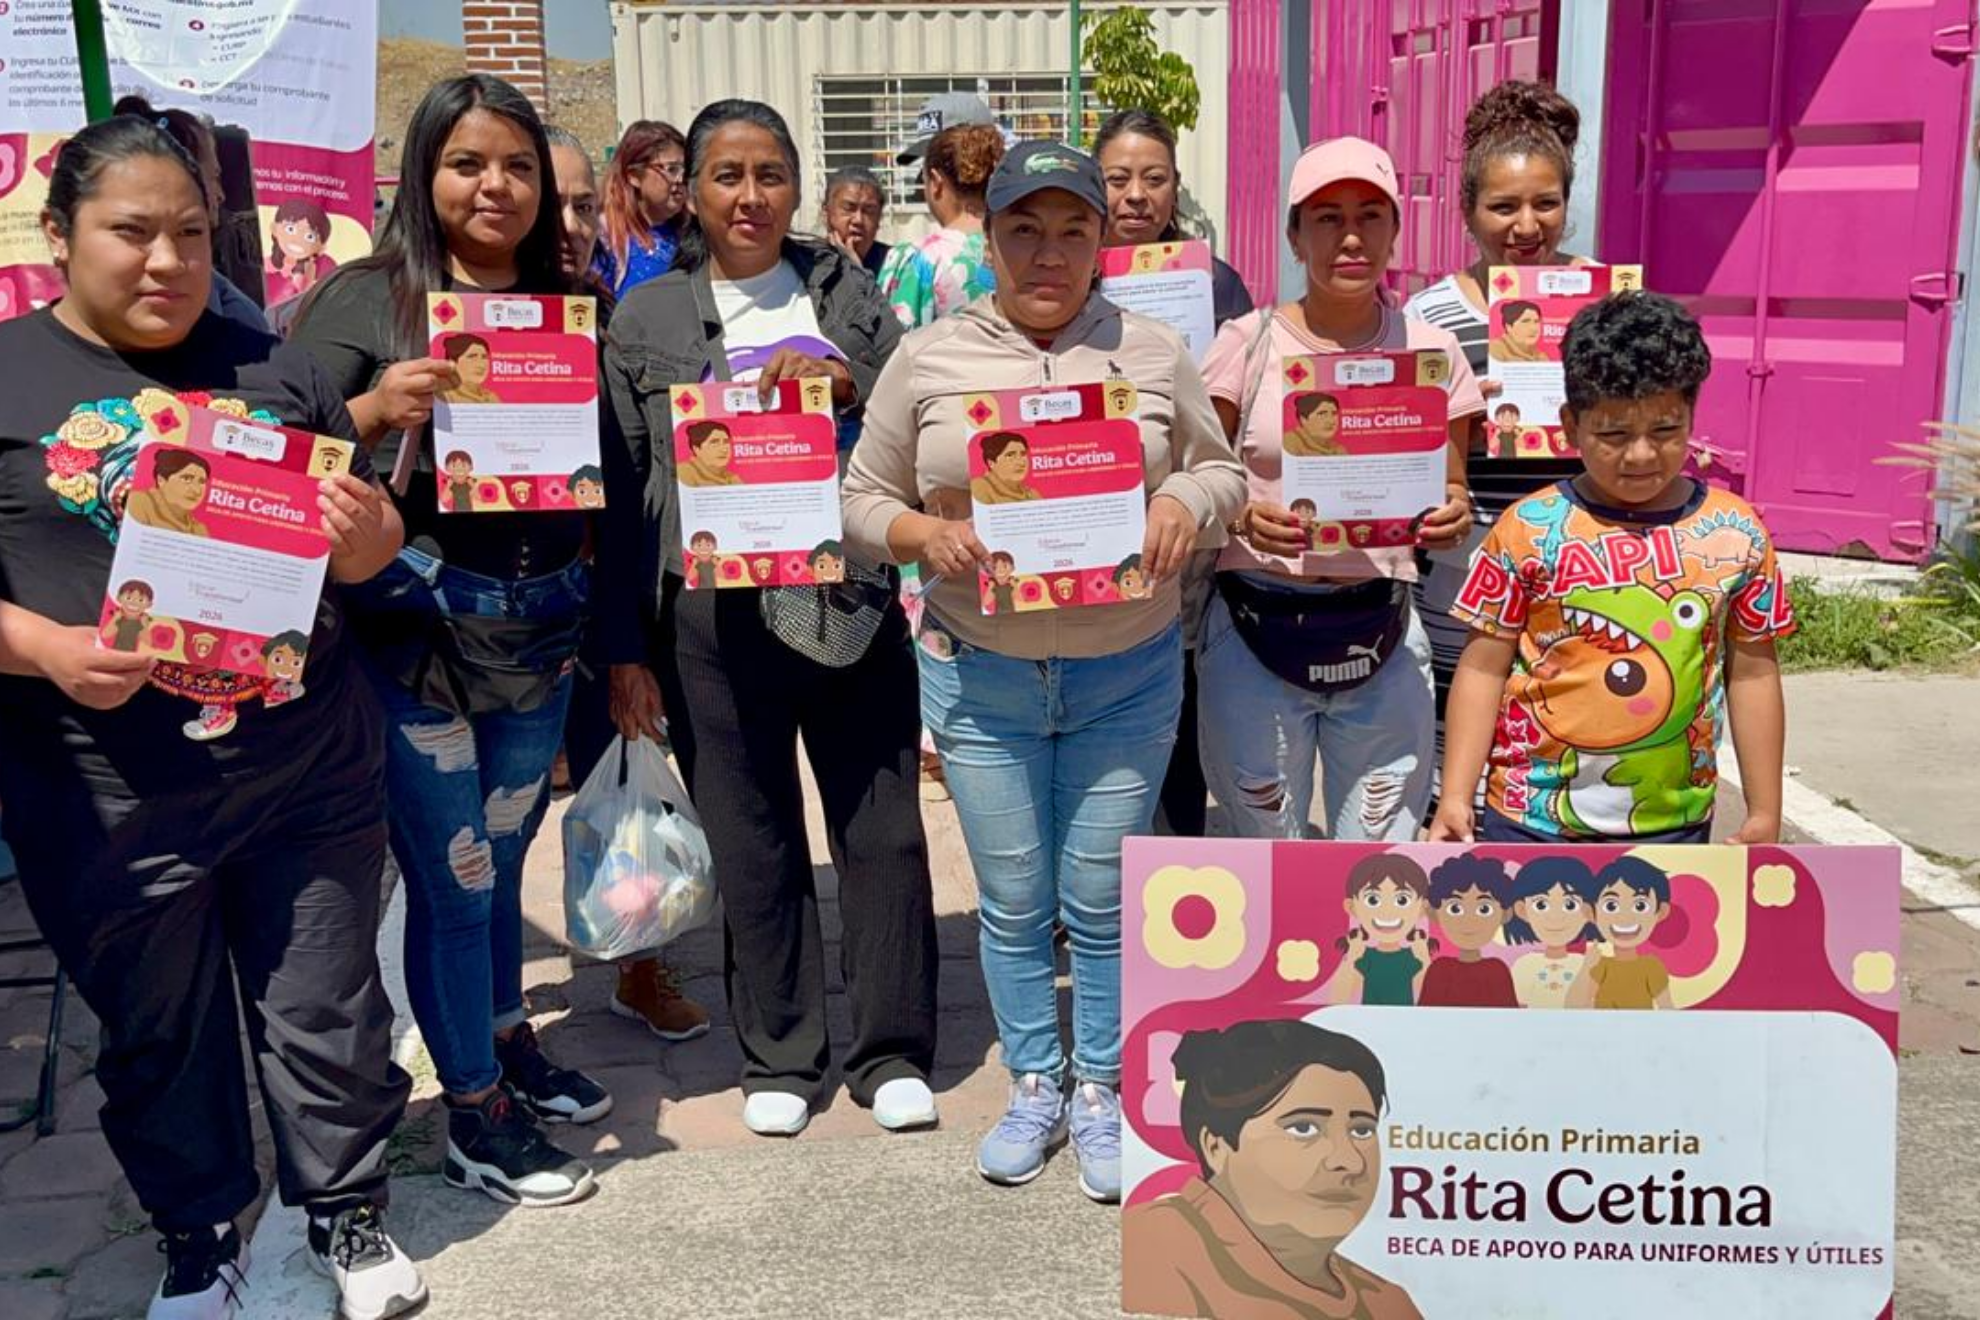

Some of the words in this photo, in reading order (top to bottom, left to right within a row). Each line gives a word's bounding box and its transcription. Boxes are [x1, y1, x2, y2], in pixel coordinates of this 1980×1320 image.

[492, 361, 522, 375] Rita
[523, 360, 572, 375] Cetina
[1341, 415, 1372, 429] Rita
[1373, 413, 1422, 428] Cetina
[733, 443, 764, 458] Rita
[765, 441, 812, 457] Cetina
[1031, 455, 1064, 471] Rita
[1065, 450, 1116, 468] Cetina
[208, 488, 246, 509] Rita
[248, 497, 306, 523] Cetina
[1309, 656, 1371, 684] PUMA
[1388, 1125, 1550, 1152] Educación
[1561, 1128, 1700, 1155] Primaria
[1388, 1165, 1527, 1223] Rita
[1546, 1168, 1772, 1227] Cetina
[1387, 1236, 1444, 1256] BECA
[1451, 1238, 1480, 1257] DE
[1486, 1239, 1567, 1260] APOYO
[1573, 1241, 1635, 1261] PARA
[1640, 1242, 1779, 1264] UNIFORMES
[1785, 1246, 1800, 1265] Y
[1806, 1241, 1884, 1265] ÚTILES
